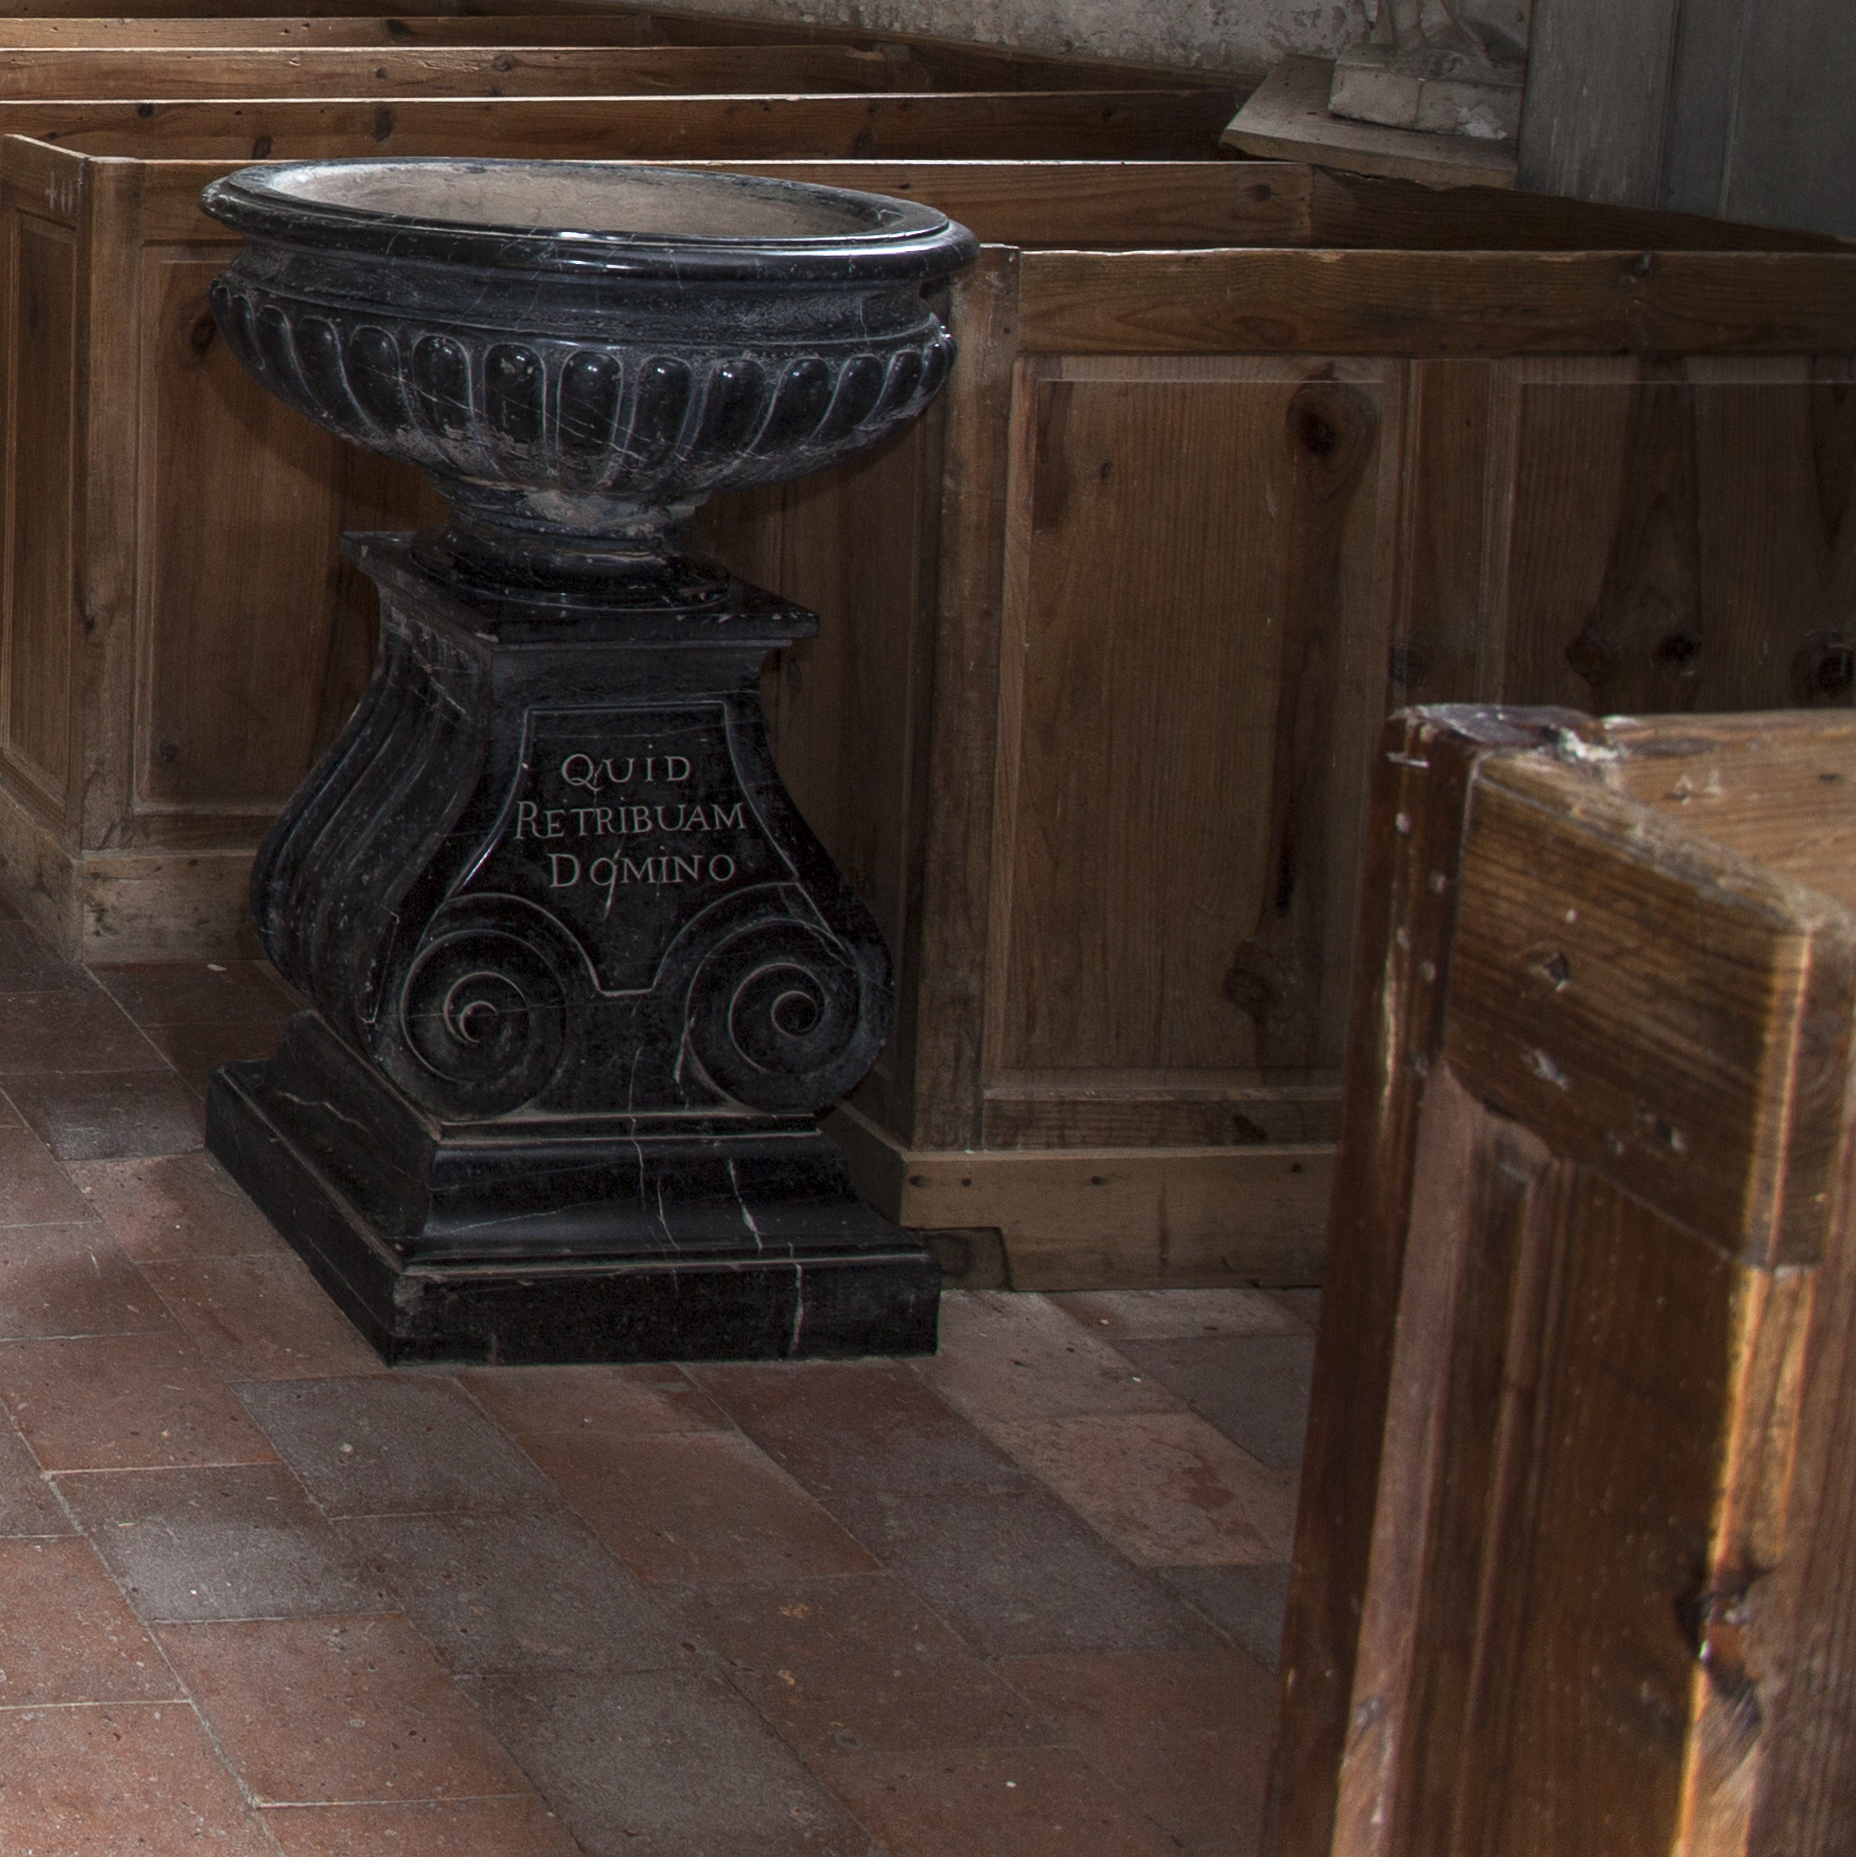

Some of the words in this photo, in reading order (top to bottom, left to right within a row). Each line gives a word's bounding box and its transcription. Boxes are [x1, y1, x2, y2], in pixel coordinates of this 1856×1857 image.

[561, 752, 691, 792] QUID
[513, 801, 749, 840] RETRIBUAM
[548, 853, 737, 888] DOMINO
